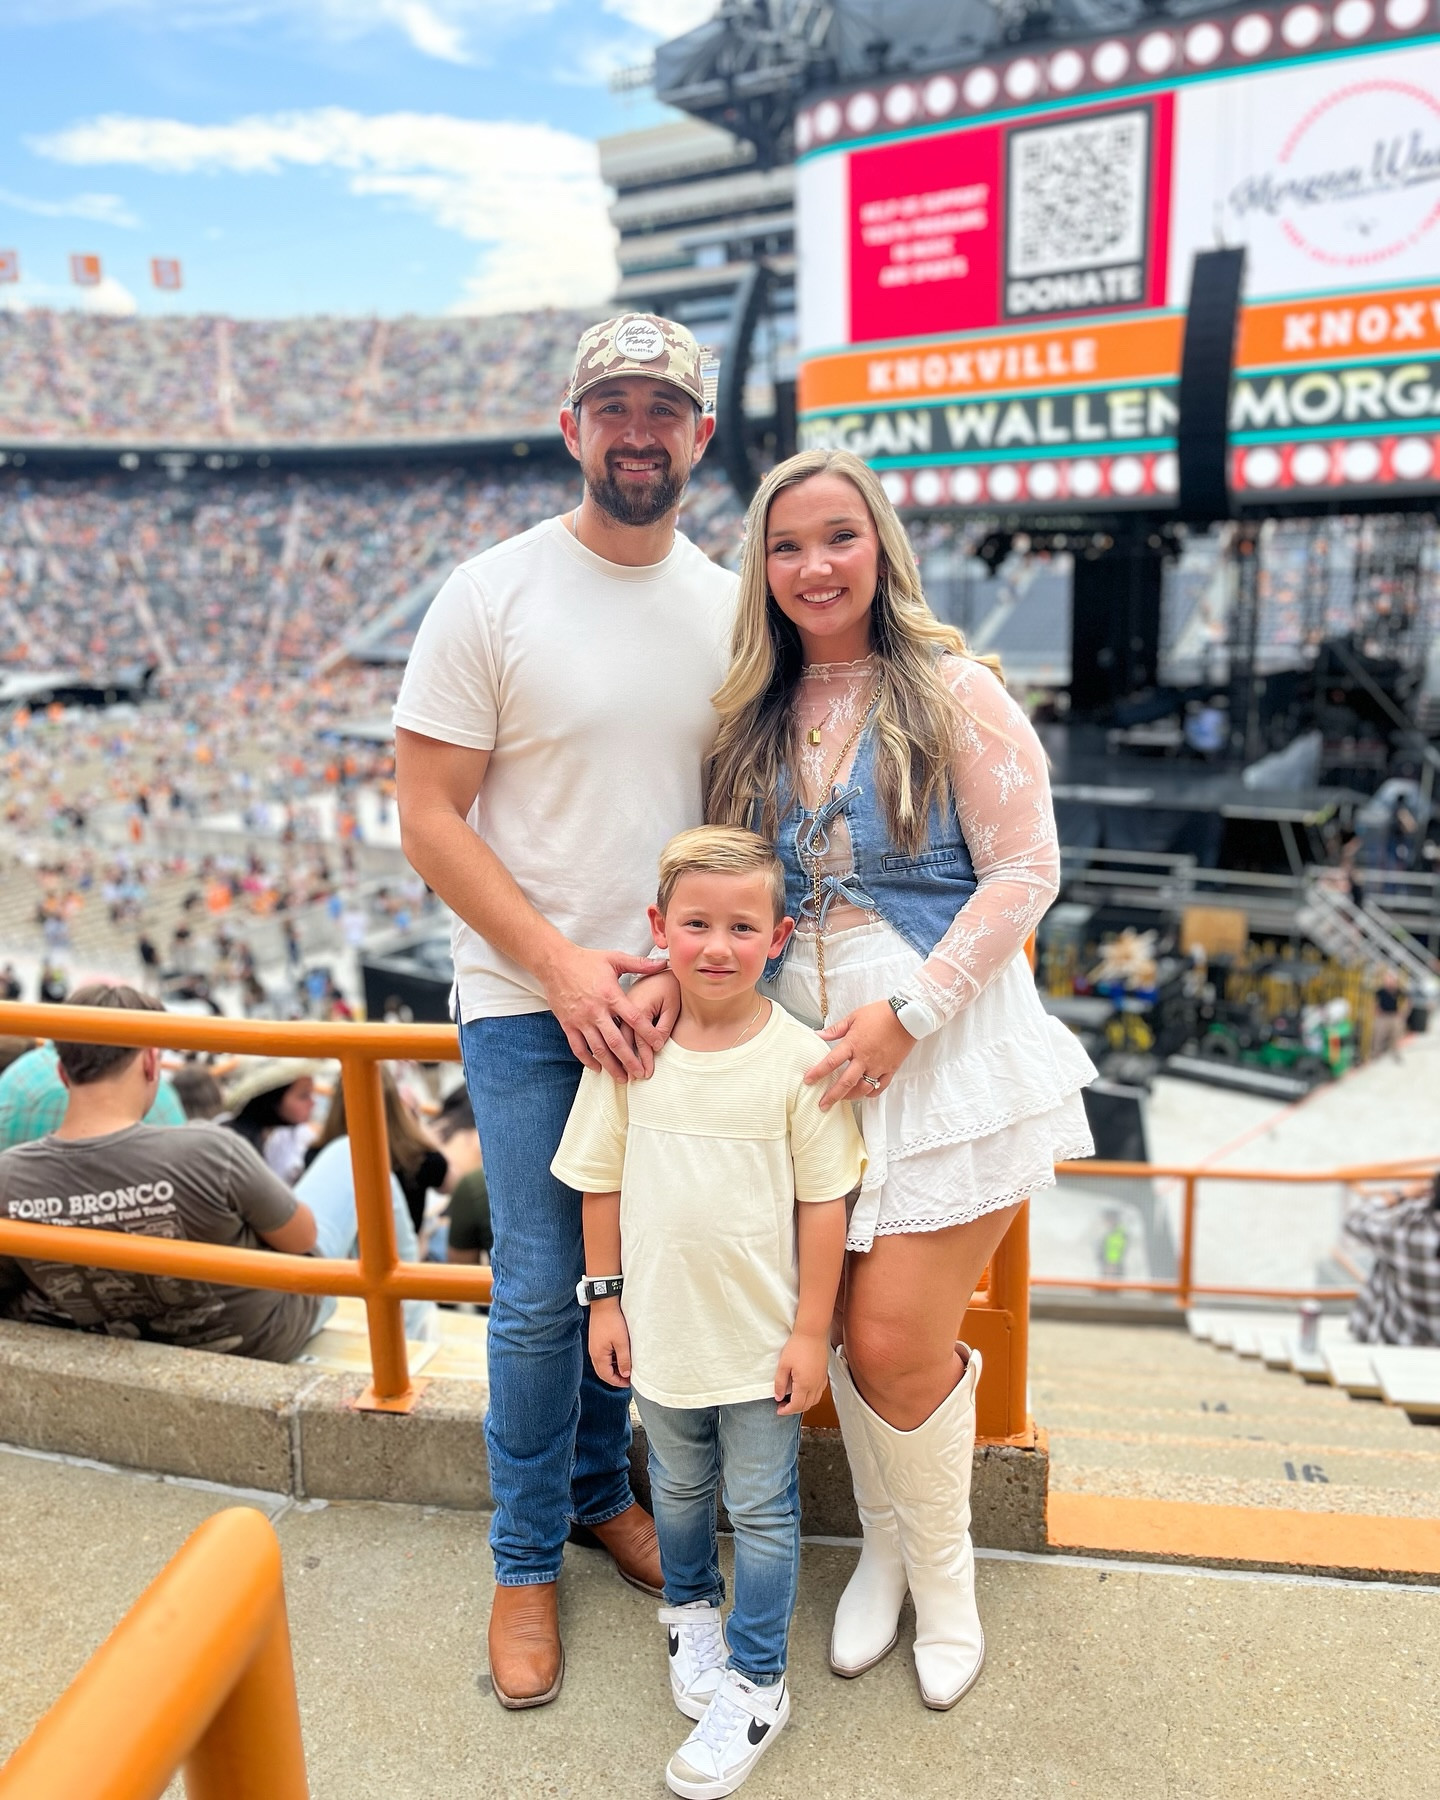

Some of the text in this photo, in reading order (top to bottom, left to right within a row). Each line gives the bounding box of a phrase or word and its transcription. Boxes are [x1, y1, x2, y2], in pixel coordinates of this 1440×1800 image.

[1007, 268, 1142, 313] DONATE
[625, 336, 657, 348] Fancy
[868, 339, 1096, 392] KNOXVILLE
[1229, 364, 1440, 427] MORG
[8, 1180, 174, 1219] FORD BRONCO
[118, 1208, 141, 1221] Ford
[1284, 1461, 1330, 1483] 16
